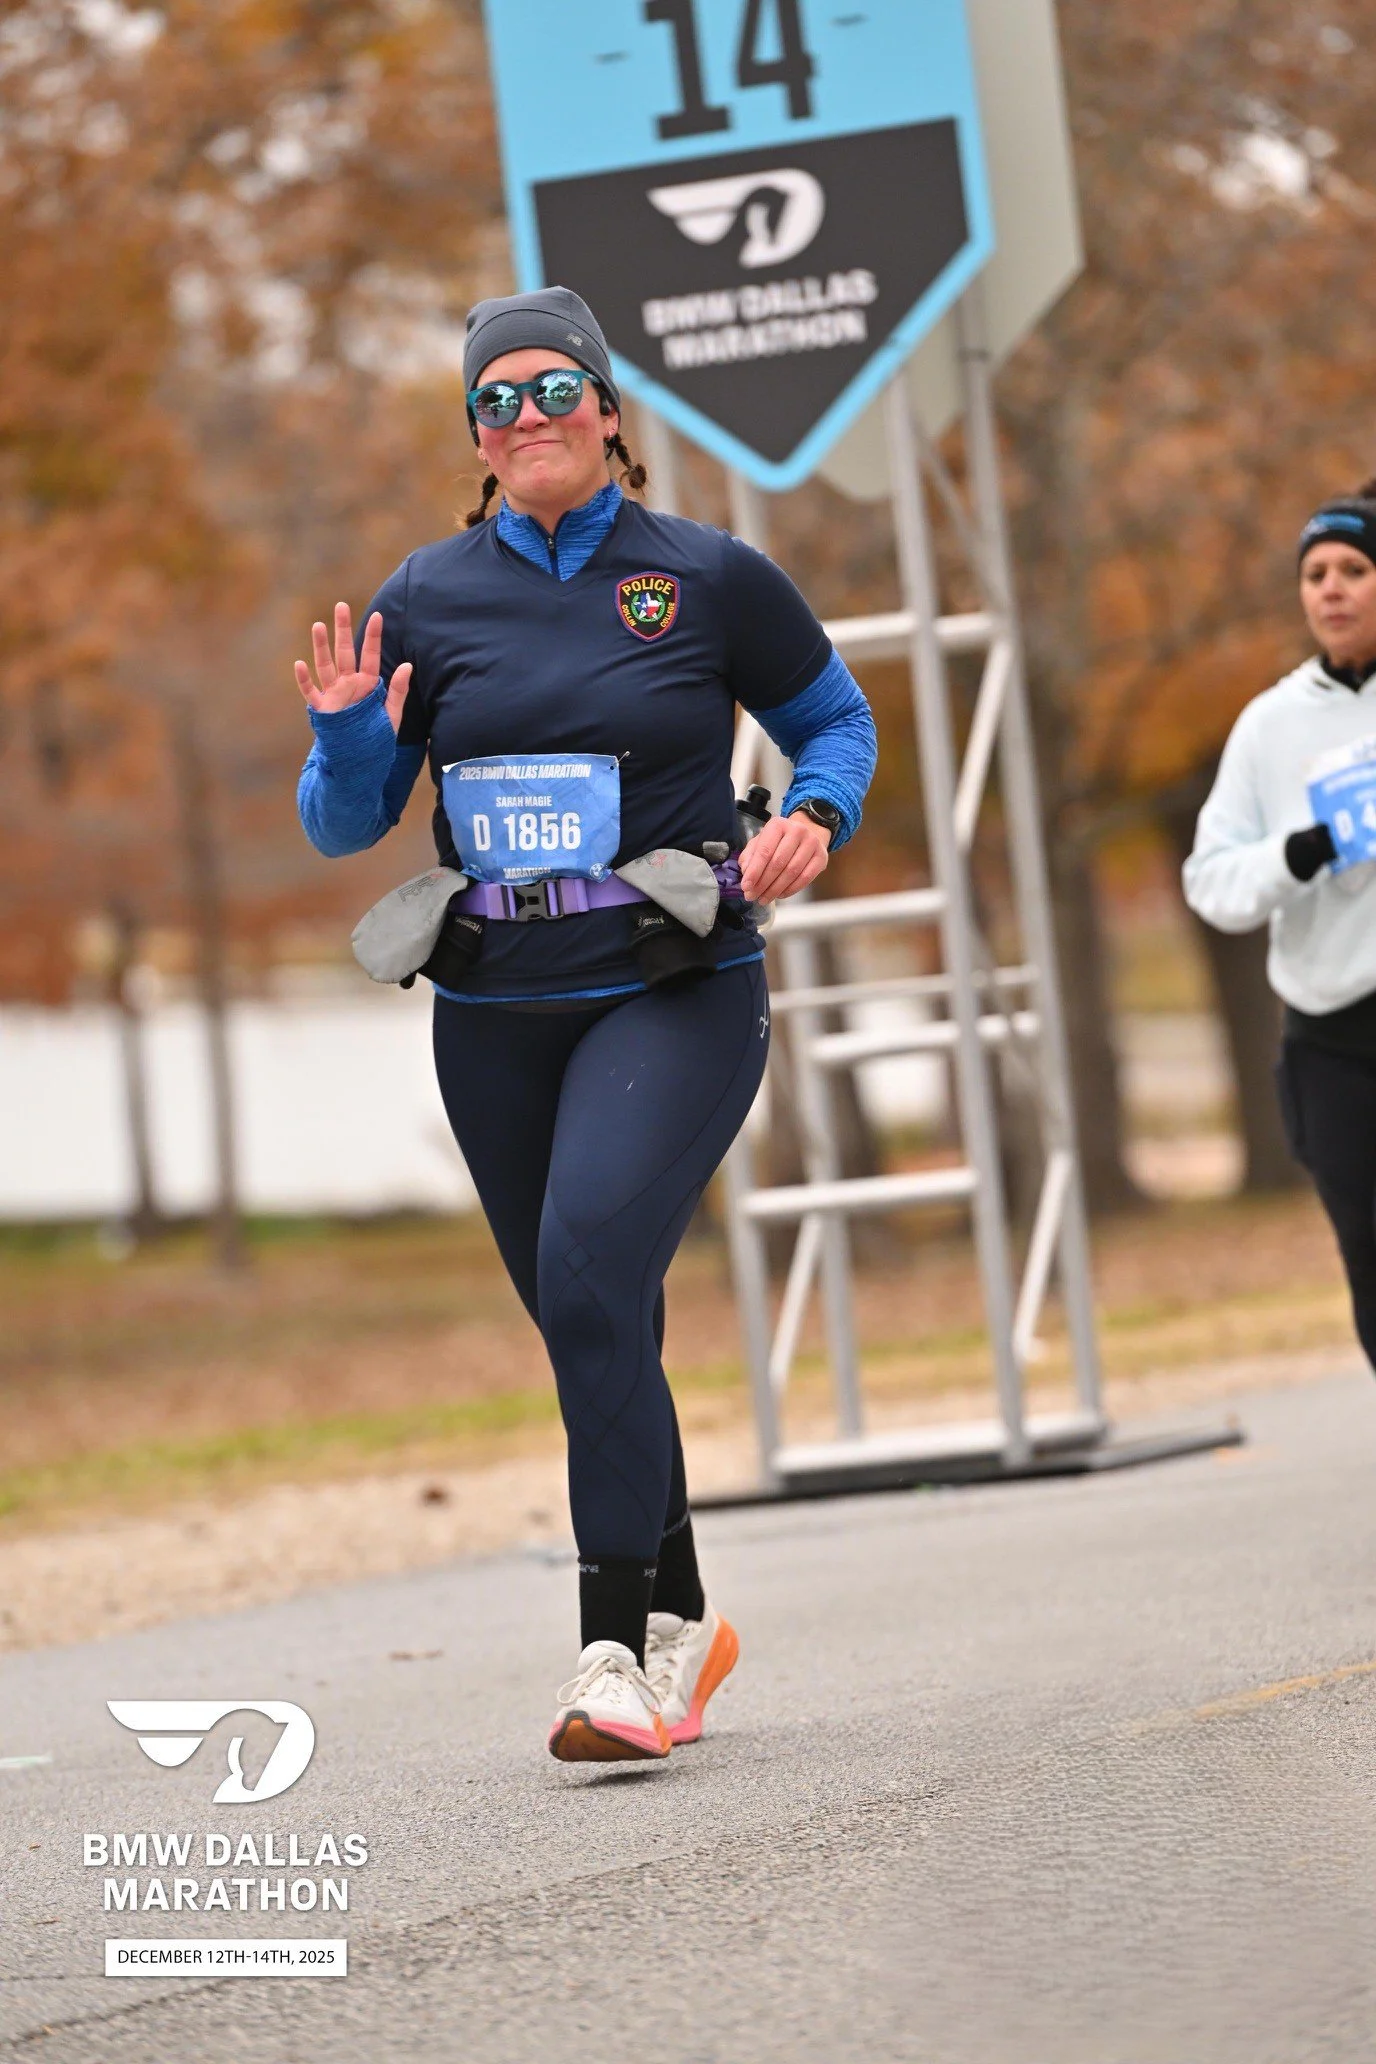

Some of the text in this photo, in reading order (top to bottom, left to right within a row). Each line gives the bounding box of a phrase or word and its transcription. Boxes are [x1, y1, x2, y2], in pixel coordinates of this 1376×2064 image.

[642, 0, 816, 140] 14
[640, 268, 879, 338] BMW DALLAS
[661, 308, 868, 371] MARATHON
[622, 578, 674, 596] POLICE
[621, 604, 638, 627] COLLIN
[660, 602, 676, 628] COLLEGE
[459, 763, 592, 781] 2025 BMW DALLAS MARATHON
[495, 795, 553, 808] SARAH MAGIE
[473, 812, 582, 852] D 1856
[503, 866, 552, 880] MARATHON
